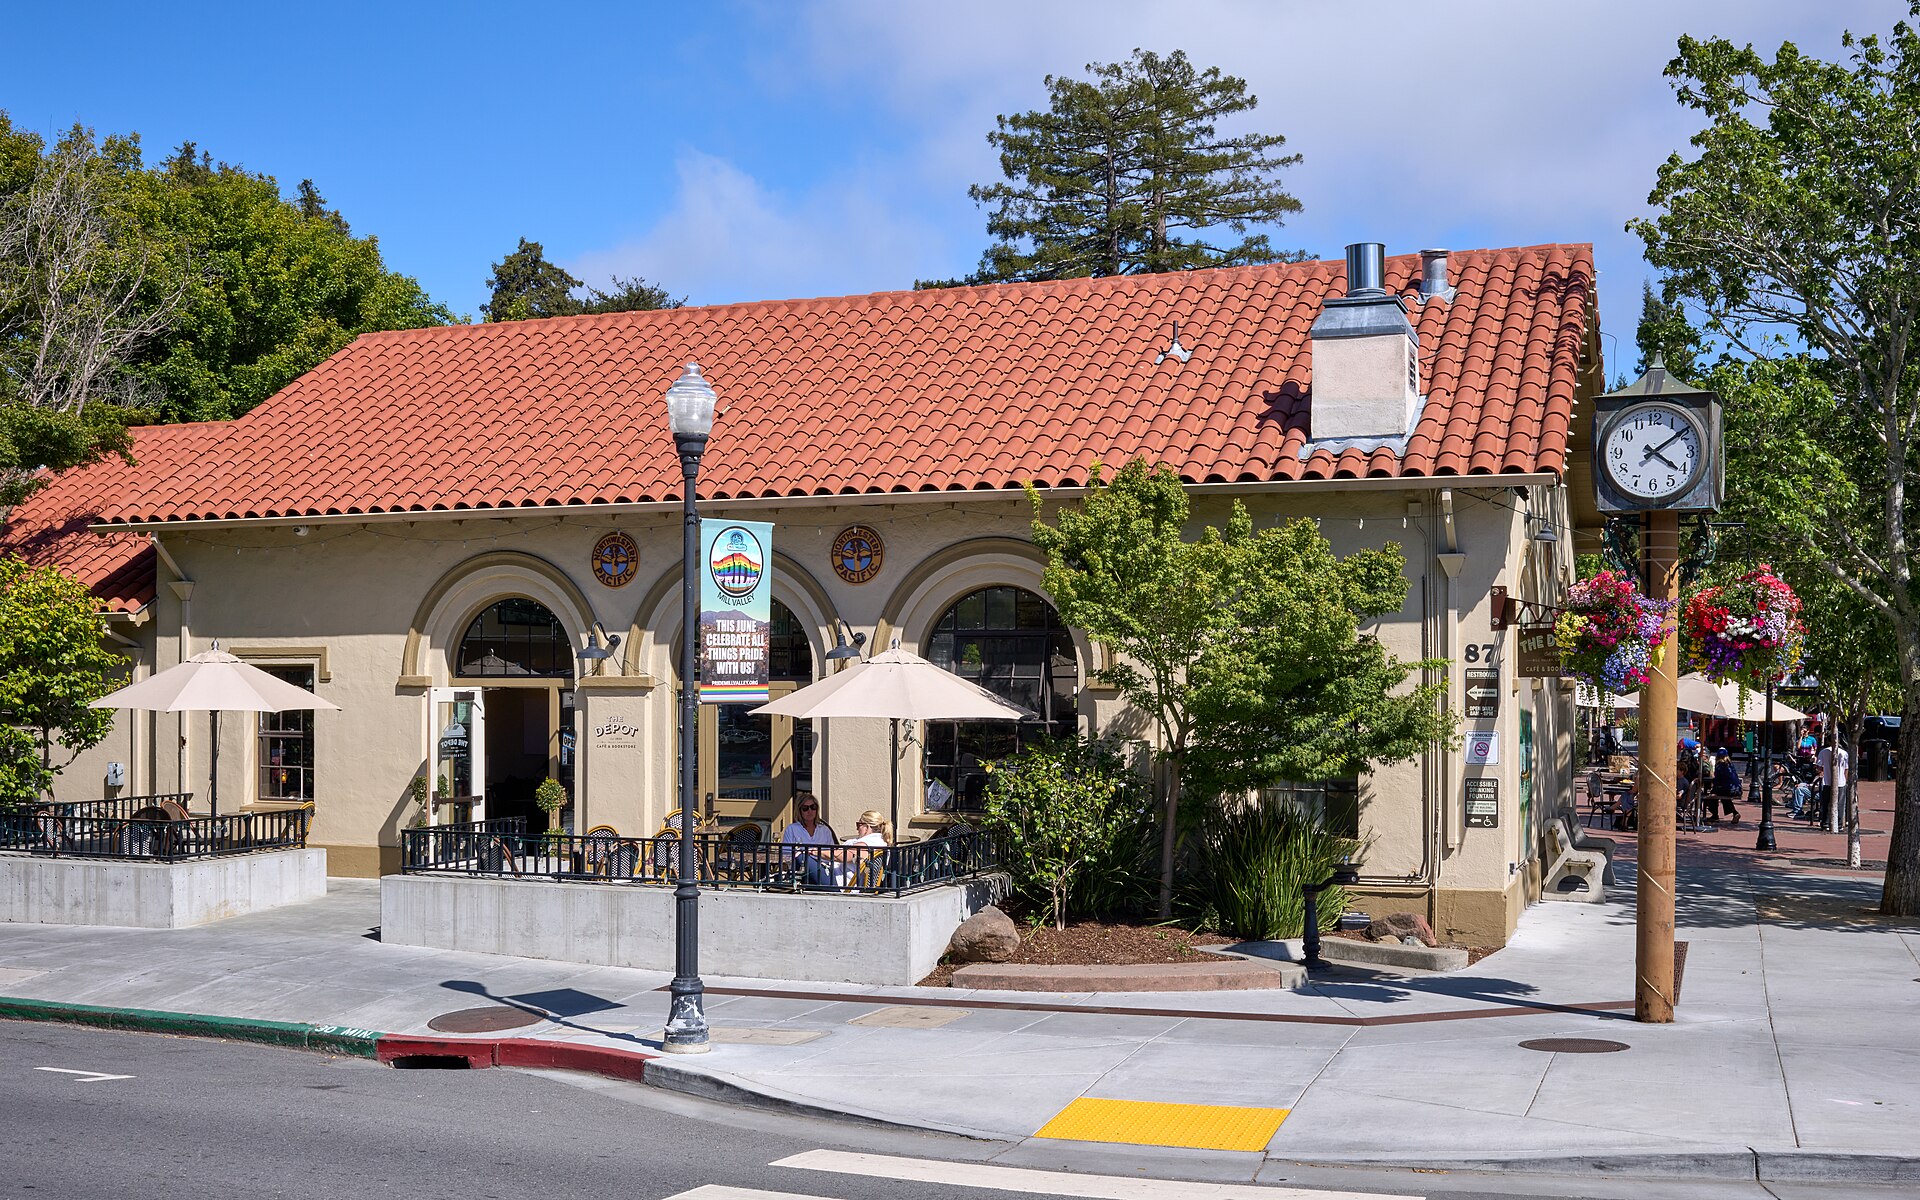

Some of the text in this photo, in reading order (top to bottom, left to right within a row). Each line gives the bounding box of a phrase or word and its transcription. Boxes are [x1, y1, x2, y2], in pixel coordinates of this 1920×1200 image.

[1634, 418, 1644, 430] 11
[1647, 412, 1662, 426] 12
[1670, 417, 1674, 429] 1
[1621, 429, 1633, 442] 10
[1680, 427, 1690, 441] 2
[1613, 447, 1623, 459] 9
[1686, 444, 1695, 458] 3
[1619, 463, 1628, 474] 8
[1678, 462, 1688, 475] 4
[1632, 474, 1641, 487] 7
[1648, 478, 1658, 491] 6
[1666, 474, 1675, 487] 5
[594, 536, 636, 562] NORTHWESTERN
[834, 530, 881, 557] NORTHWESTERN
[596, 568, 632, 585] PACIFIC
[836, 563, 878, 581] PACIFIC
[717, 592, 755, 606] MILL VALLEY
[716, 620, 757, 632] THIS JUNE
[706, 633, 765, 646] CELEBRATE ALL
[1520, 635, 1544, 653] THE
[707, 647, 764, 660] THINGS PRIDE
[1464, 643, 1495, 663] 87
[716, 661, 755, 674] WITH US!
[594, 723, 639, 737] DEPOT
[314, 1024, 338, 1033] 30
